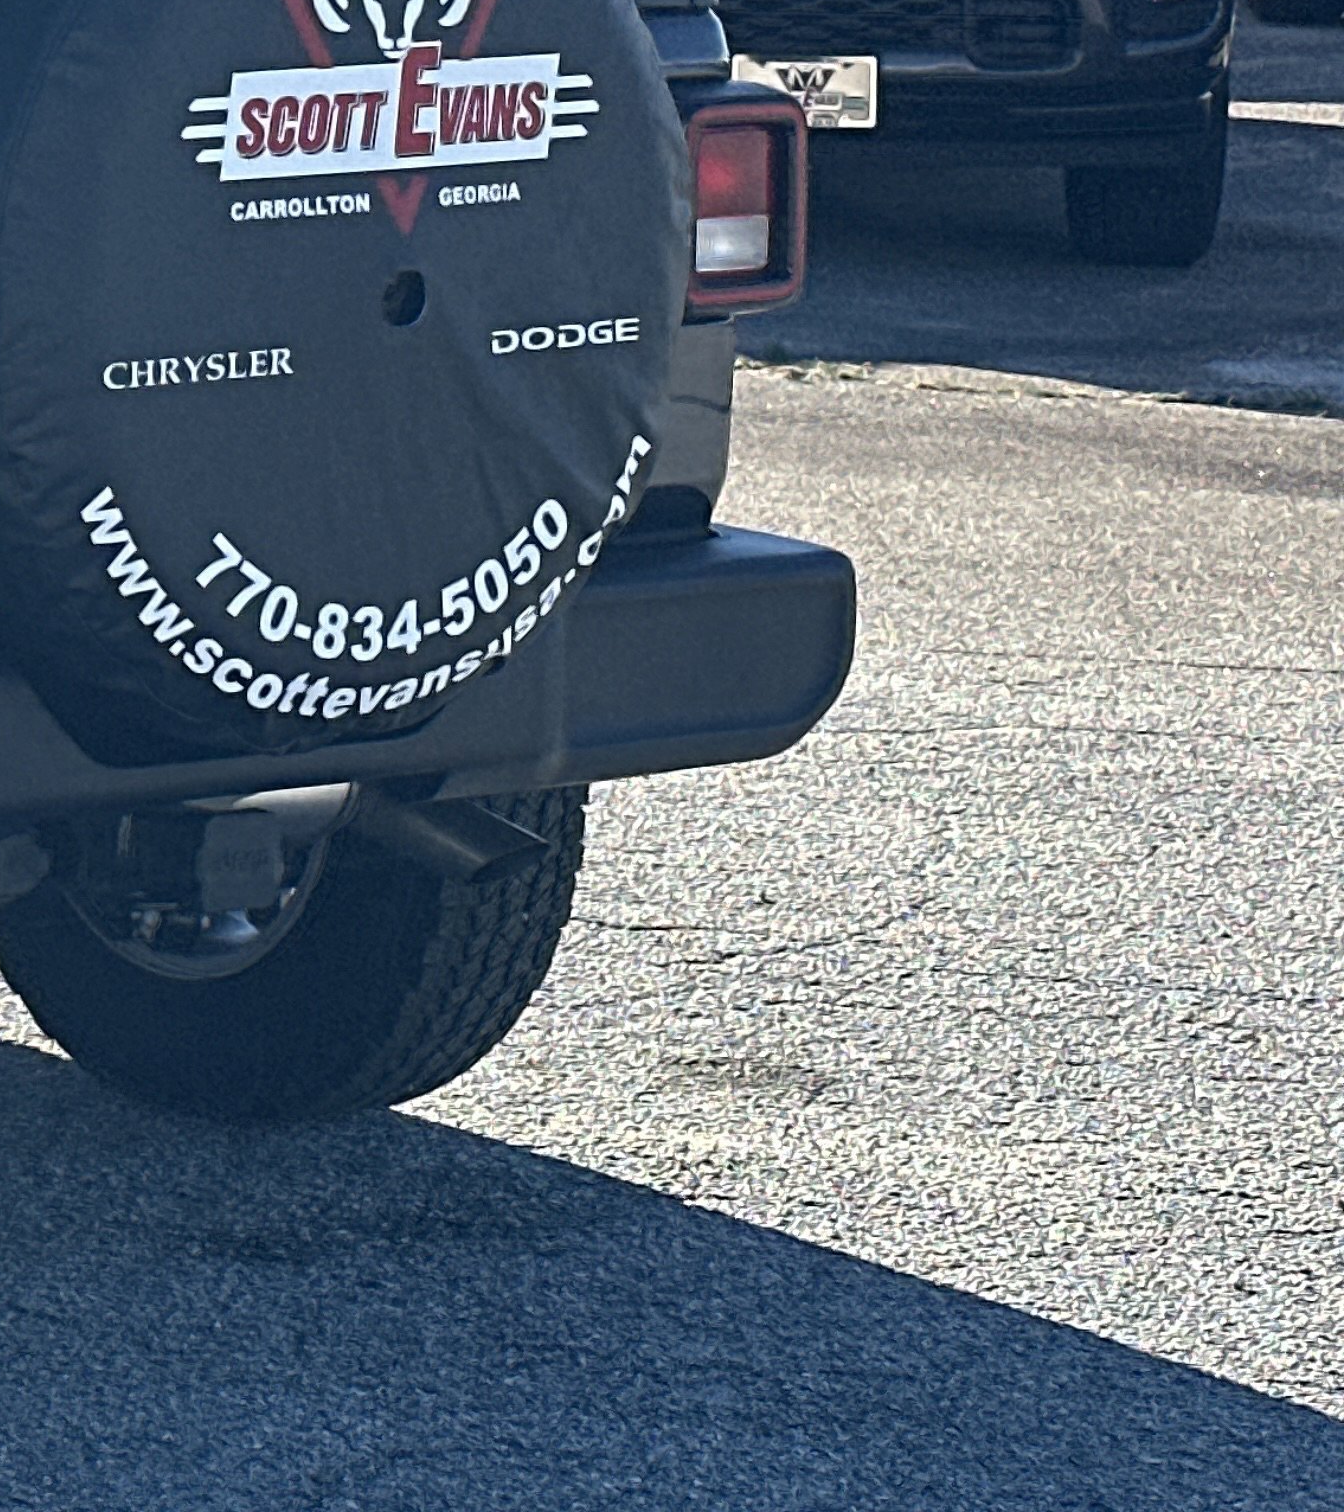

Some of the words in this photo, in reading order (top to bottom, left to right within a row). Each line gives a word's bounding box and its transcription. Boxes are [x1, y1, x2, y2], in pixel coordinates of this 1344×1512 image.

[236, 90, 388, 159] SCOTT
[394, 41, 549, 159] EVANS
[230, 193, 371, 222] CARROLLTON
[438, 182, 521, 208] GEORGIA
[491, 317, 640, 354] DODGE
[103, 347, 294, 390] CHRYSLER
[195, 498, 568, 662] 770-834-5050
